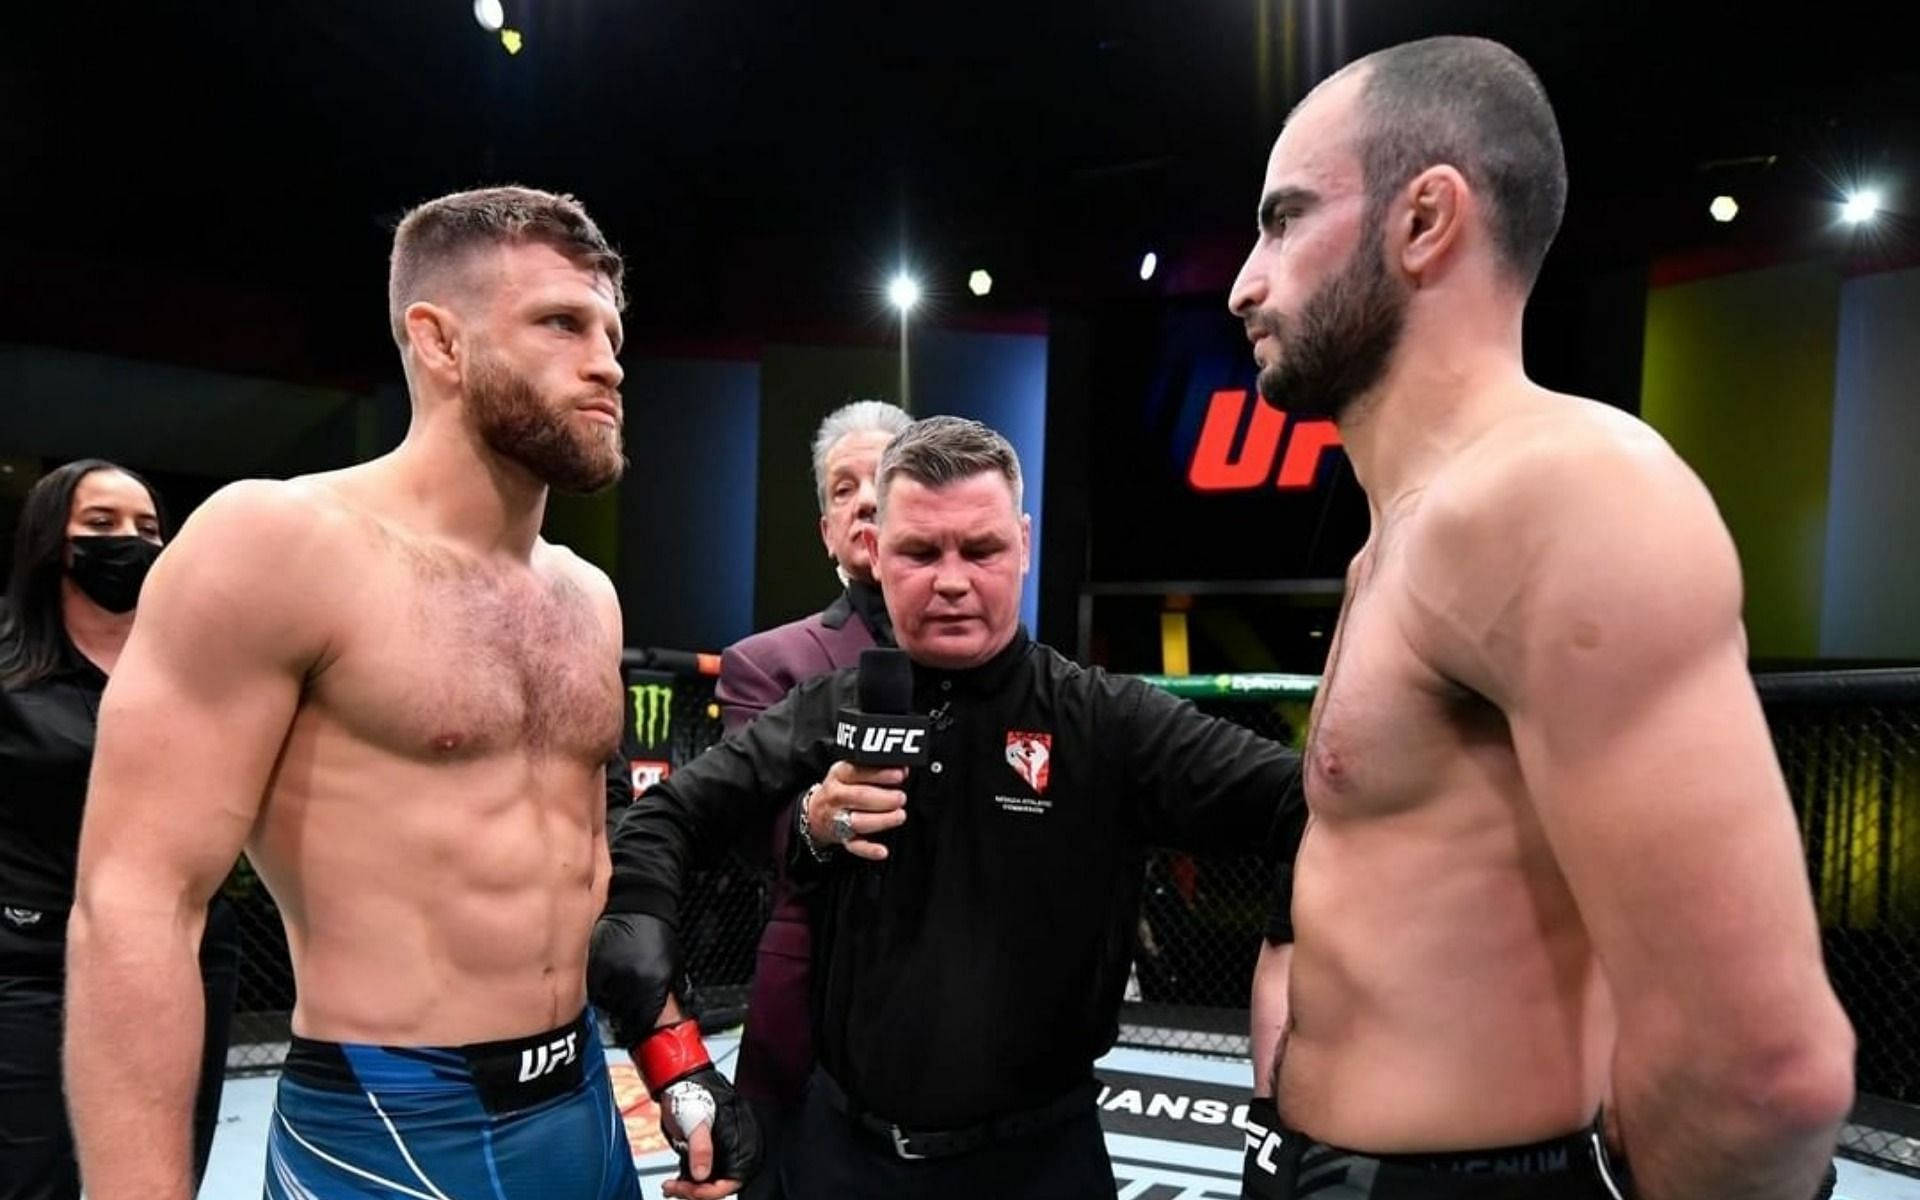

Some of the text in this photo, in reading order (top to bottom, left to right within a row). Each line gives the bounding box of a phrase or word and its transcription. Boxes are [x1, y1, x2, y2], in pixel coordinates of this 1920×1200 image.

[1189, 390, 1343, 490] UF
[862, 727, 925, 753] UFC
[518, 1031, 577, 1083] UFC
[1246, 1119, 1283, 1176] FC
